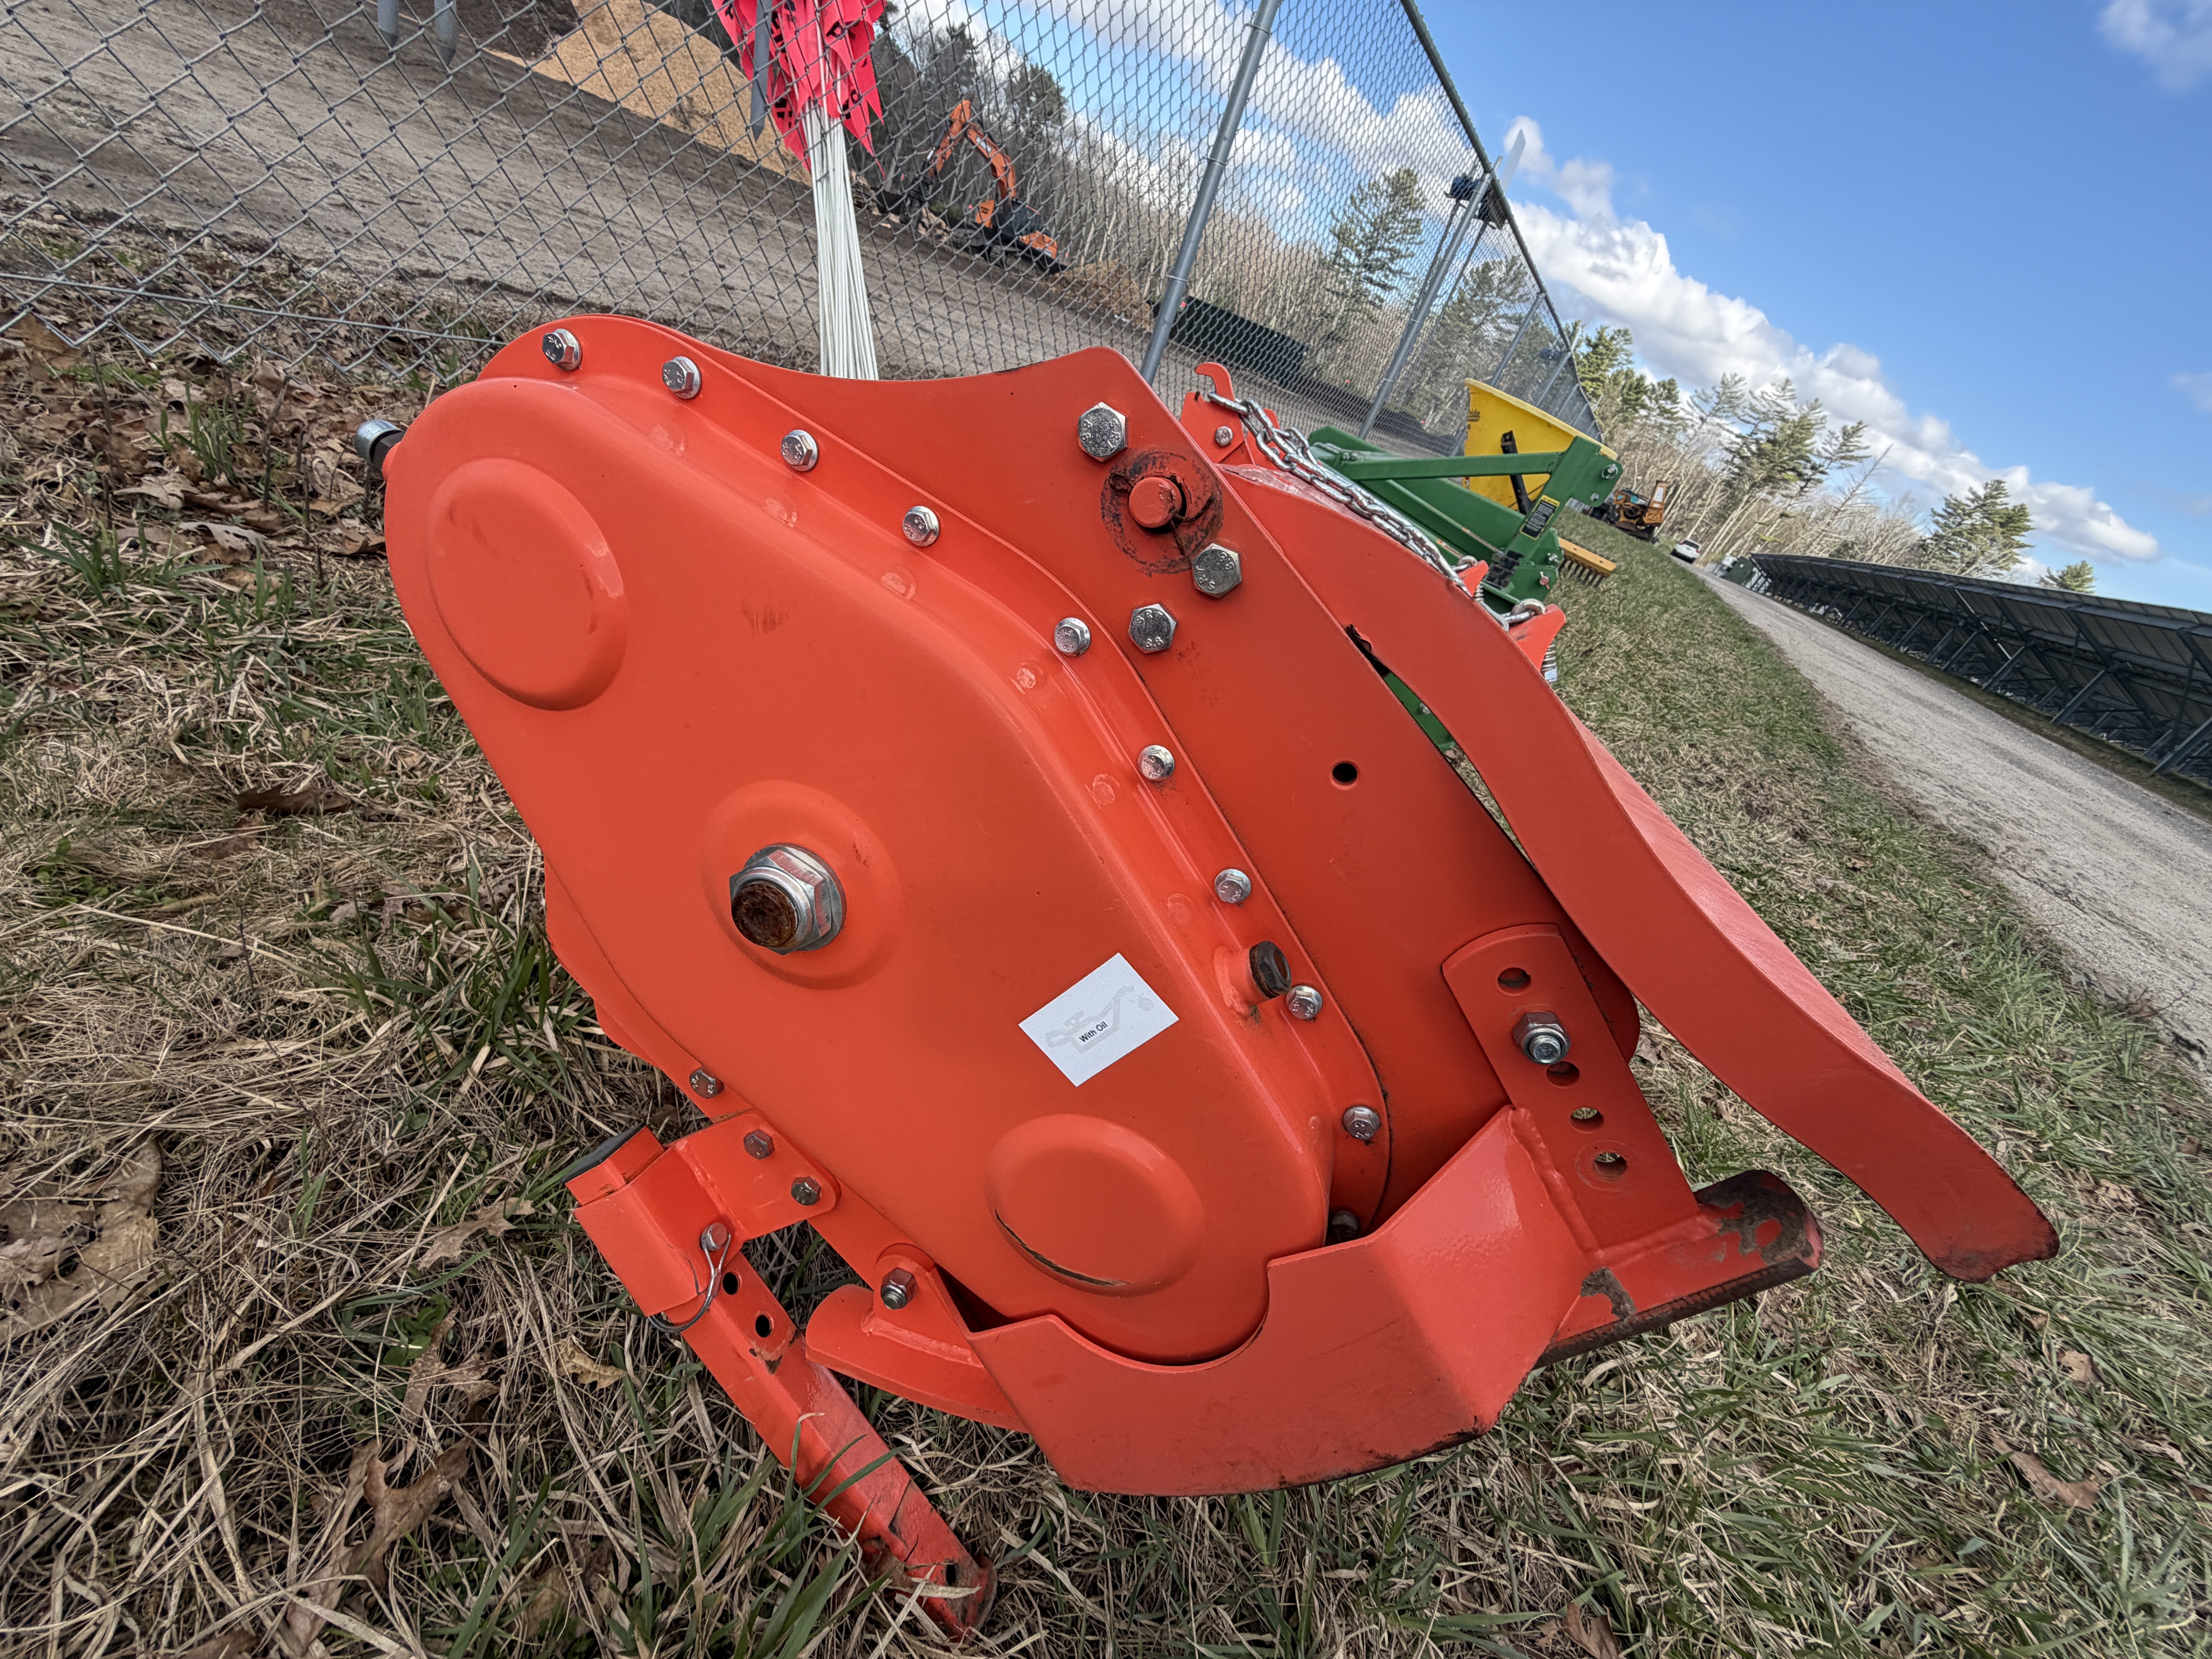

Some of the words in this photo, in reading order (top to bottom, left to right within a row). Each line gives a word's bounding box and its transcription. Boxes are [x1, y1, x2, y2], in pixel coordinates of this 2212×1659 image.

[1219, 551, 1235, 570] 8.8
[1146, 636, 1164, 648] 8.8
[1079, 1030, 1097, 1042] With
[1096, 1021, 1108, 1031] Oil
